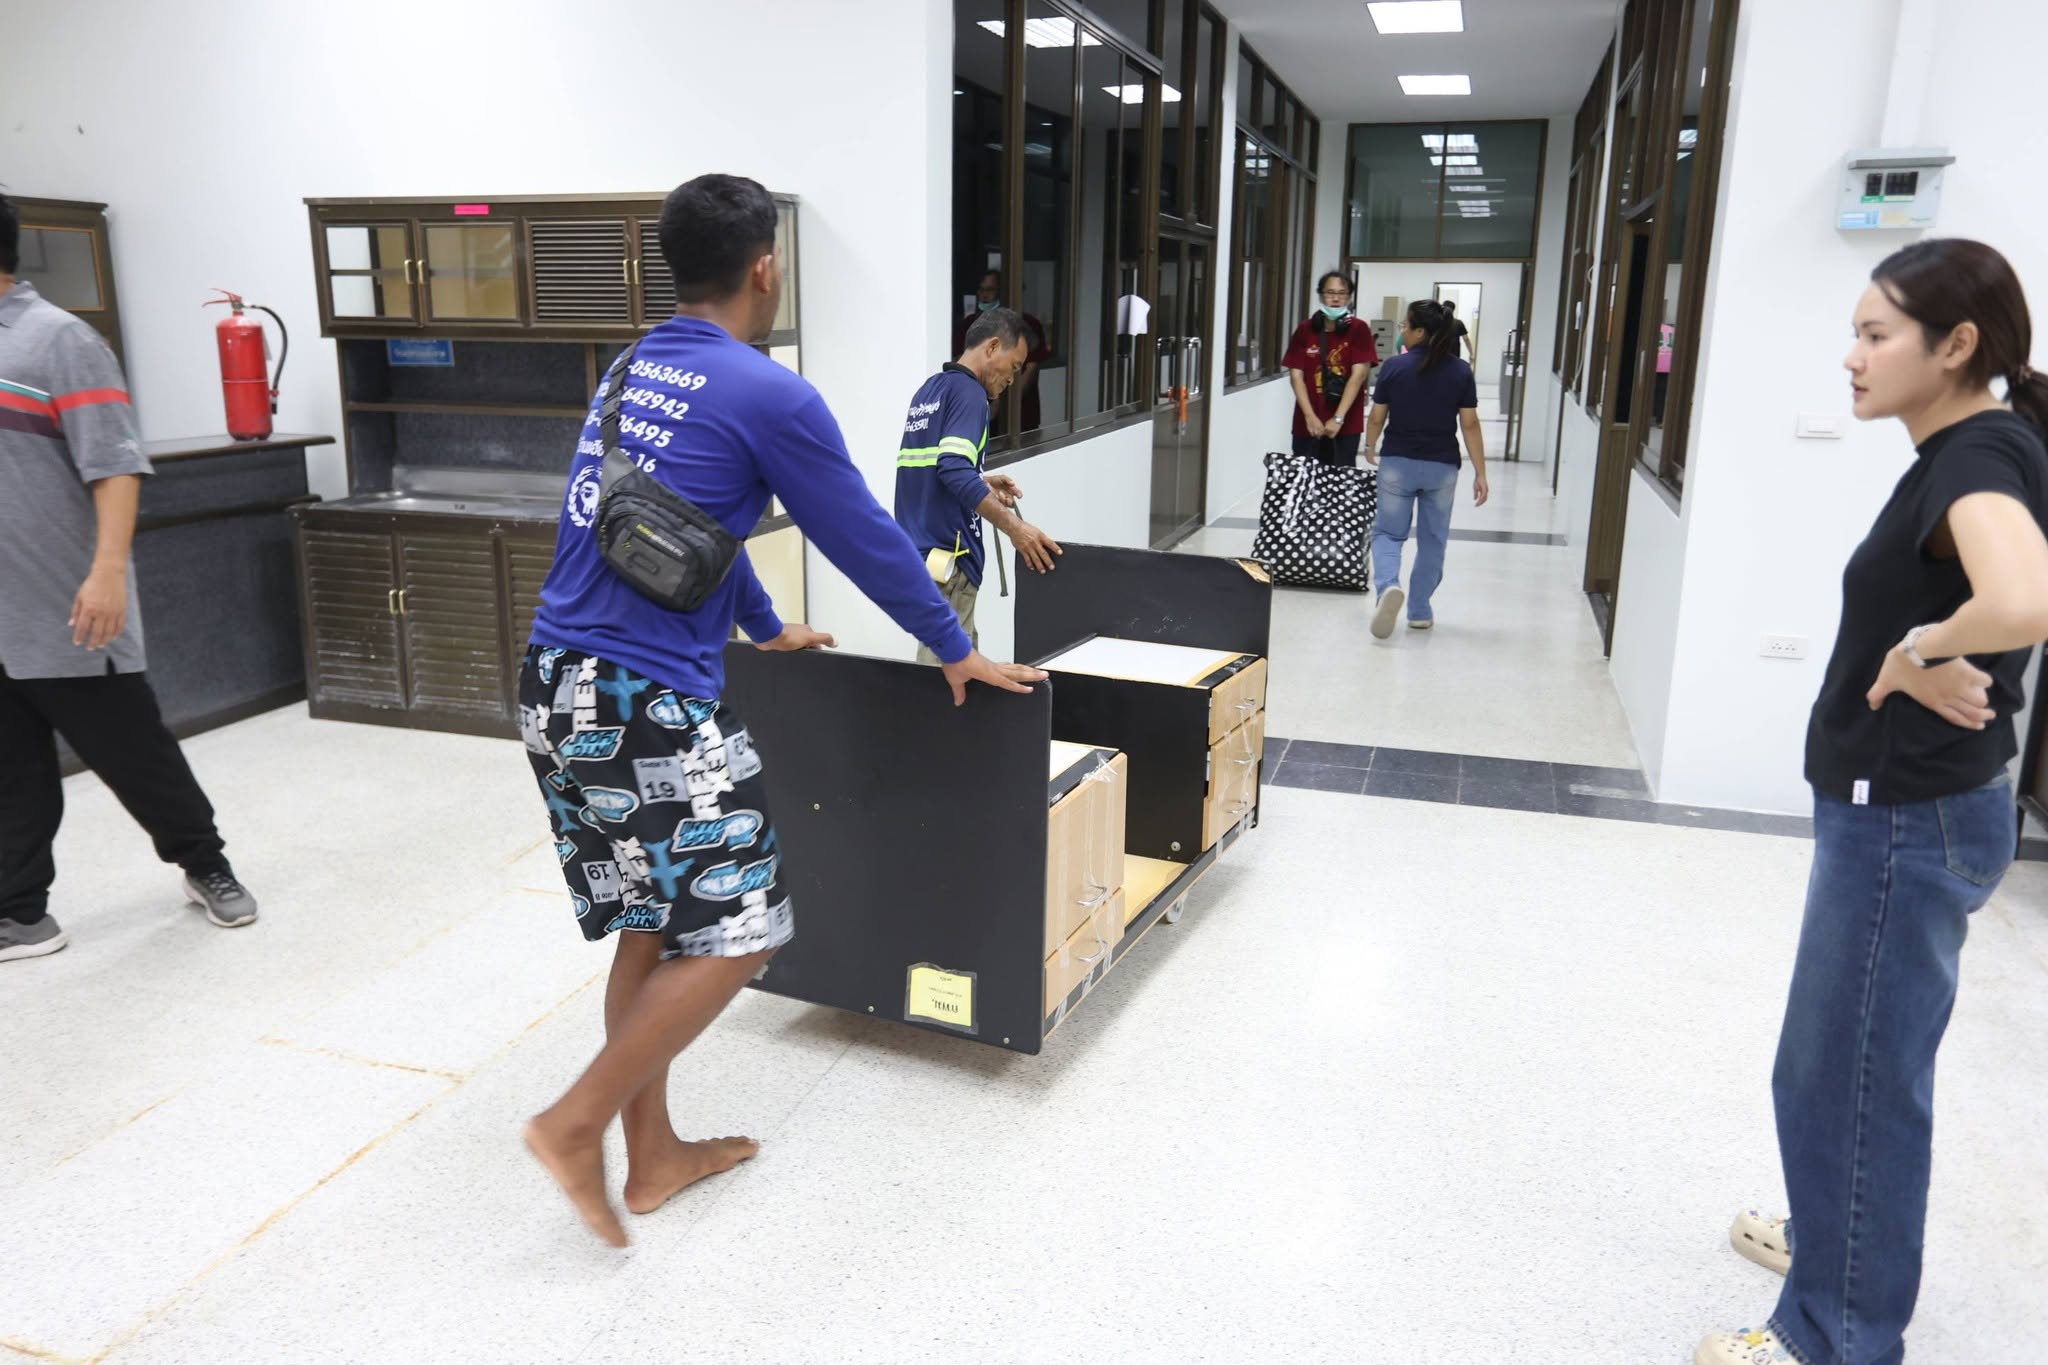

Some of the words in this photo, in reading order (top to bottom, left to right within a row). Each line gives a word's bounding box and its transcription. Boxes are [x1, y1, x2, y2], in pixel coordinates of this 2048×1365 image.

[610, 356, 707, 391] -0563669
[636, 453, 657, 473] 16
[645, 781, 675, 800] 19
[587, 863, 609, 881] 19
